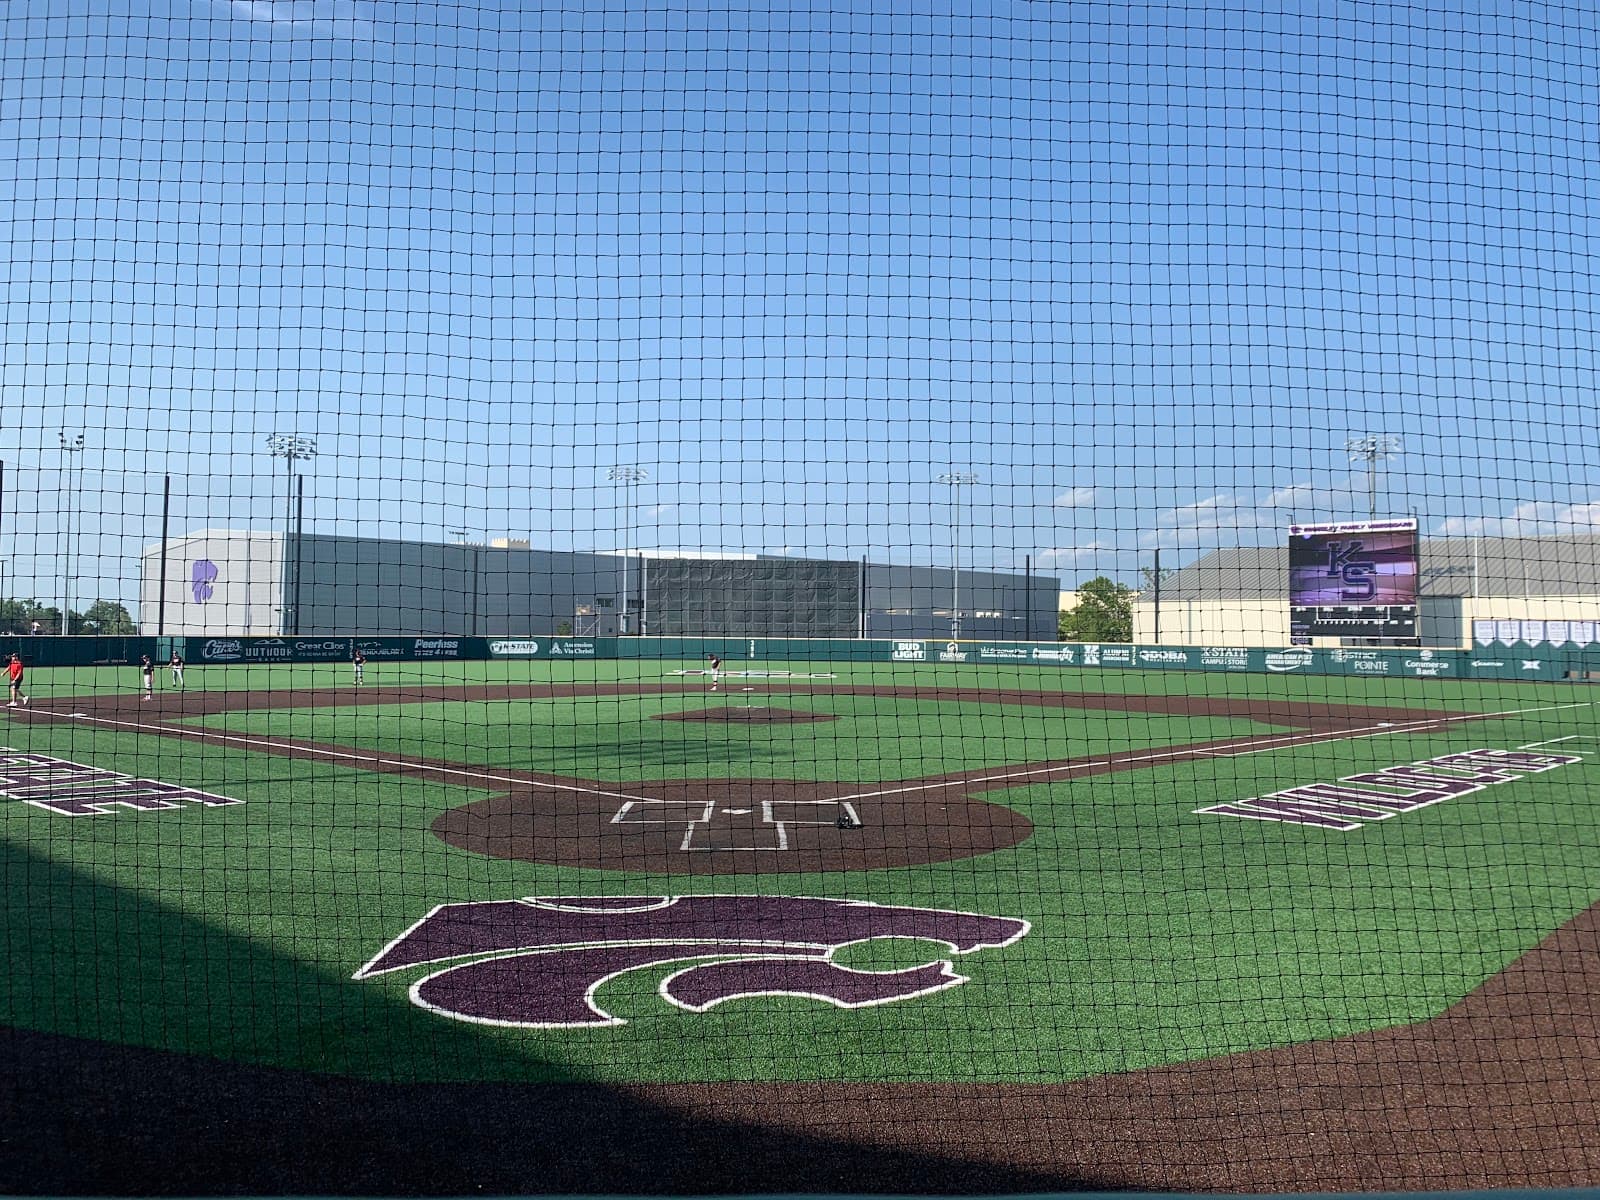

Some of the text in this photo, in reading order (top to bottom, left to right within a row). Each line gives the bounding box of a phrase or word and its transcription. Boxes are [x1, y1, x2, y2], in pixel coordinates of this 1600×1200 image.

[296, 642, 345, 650] Great Clips
[415, 639, 458, 648] Peerless
[245, 647, 293, 657] OUTDOOR
[1139, 651, 1187, 660] QDOBA
[1201, 647, 1247, 657] K-STATE
[1354, 661, 1389, 670] POINTE
[1405, 660, 1449, 669] Commerce
[1416, 668, 1440, 676] Bank
[1192, 749, 1584, 832] WILDCATS
